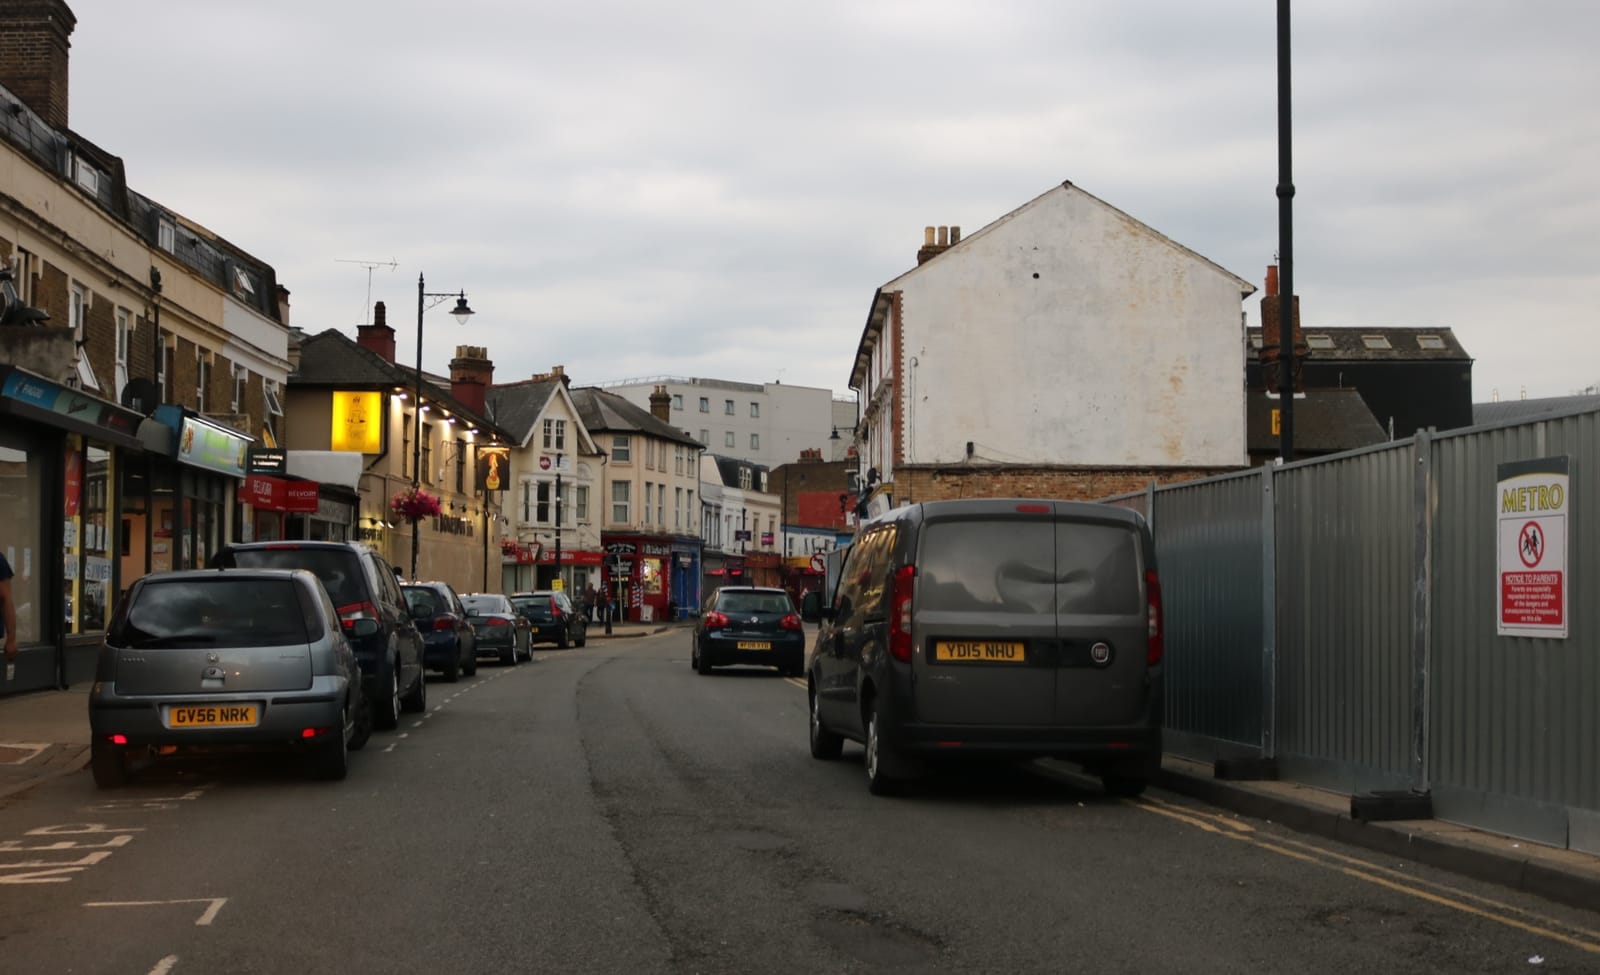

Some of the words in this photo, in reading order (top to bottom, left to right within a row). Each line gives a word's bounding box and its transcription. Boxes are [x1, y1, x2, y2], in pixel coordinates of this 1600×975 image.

[1501, 483, 1564, 513] METRO
[1505, 575, 1524, 584] NOTICE
[1525, 574, 1532, 583] TO
[1533, 574, 1558, 584] PARENTS
[985, 643, 1014, 659] NHU
[176, 709, 216, 722] GV56
[219, 708, 250, 722] NRK
